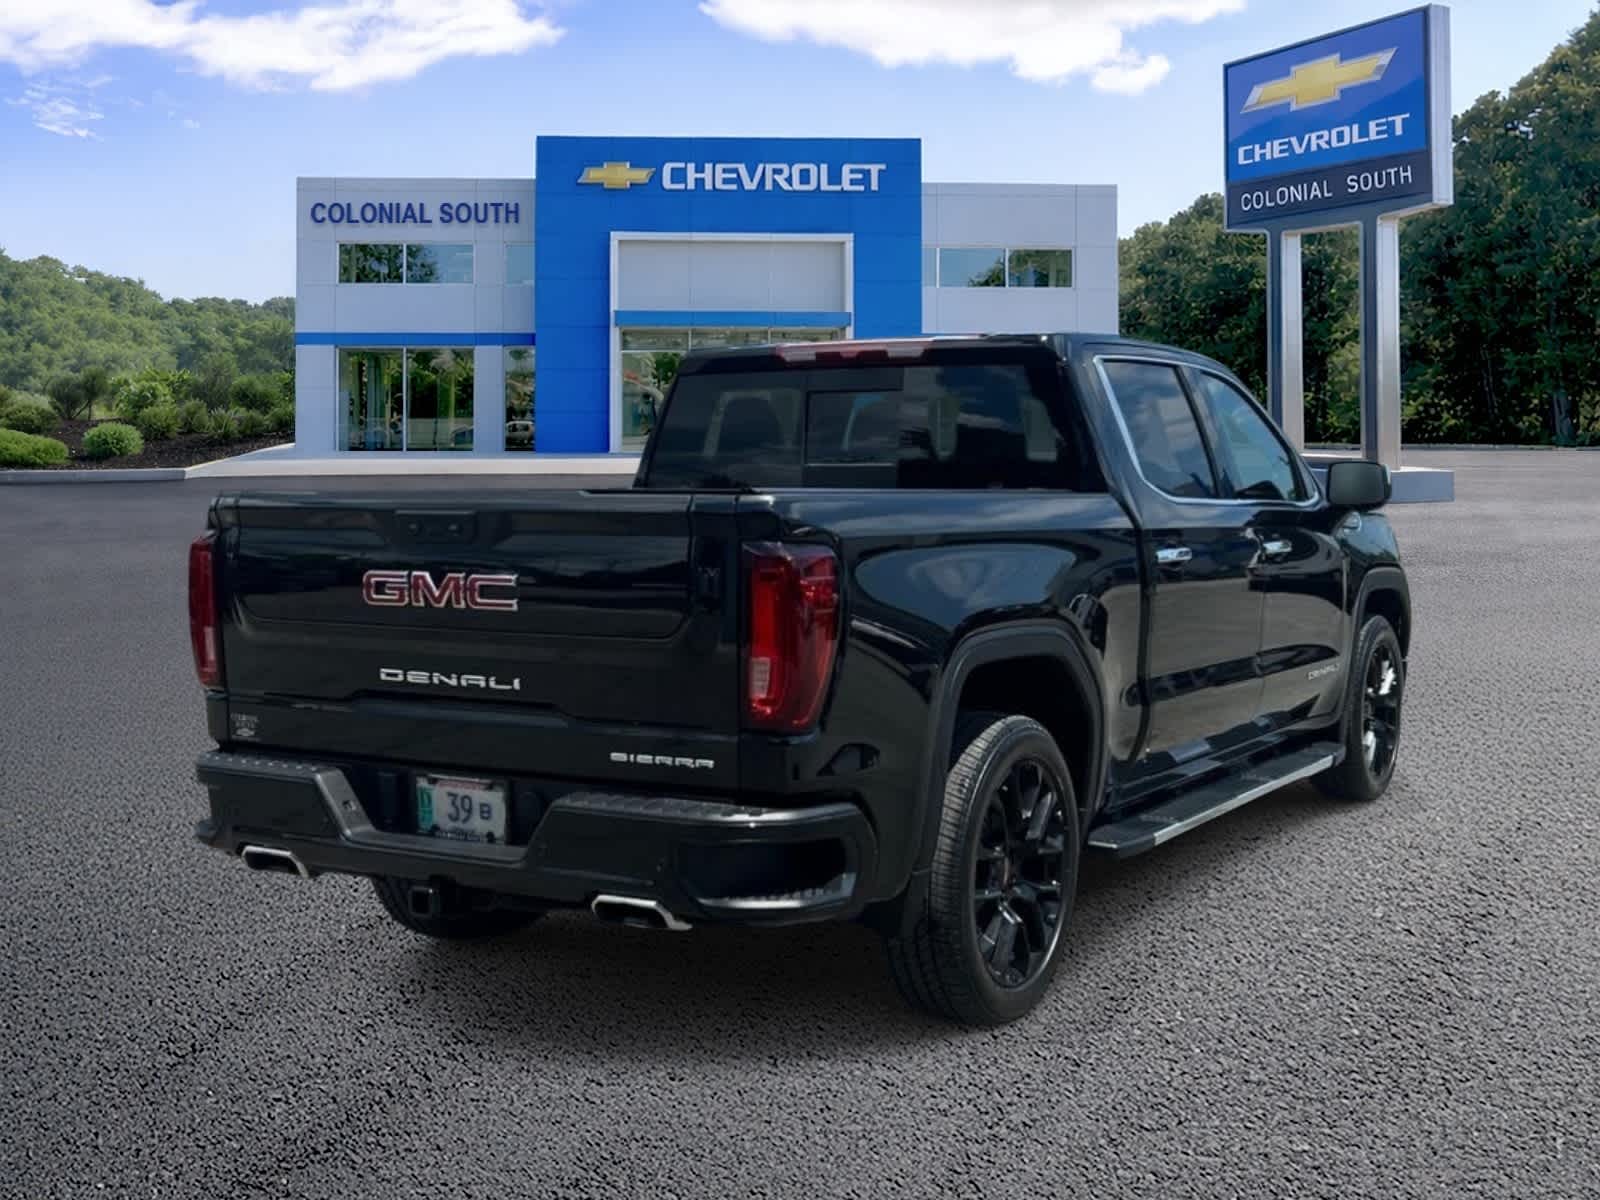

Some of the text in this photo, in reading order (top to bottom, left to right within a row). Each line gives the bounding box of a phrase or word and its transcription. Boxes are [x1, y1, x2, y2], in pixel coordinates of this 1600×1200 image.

[1238, 113, 1410, 165] CHEVROLET
[661, 161, 887, 192] CHEVROLET
[1241, 165, 1413, 212] COLONIAL SOUTH
[310, 202, 521, 225] COLONIAL SOUTH
[362, 570, 519, 612] GMC
[379, 667, 521, 690] DENALI
[610, 752, 715, 768] SIERRA
